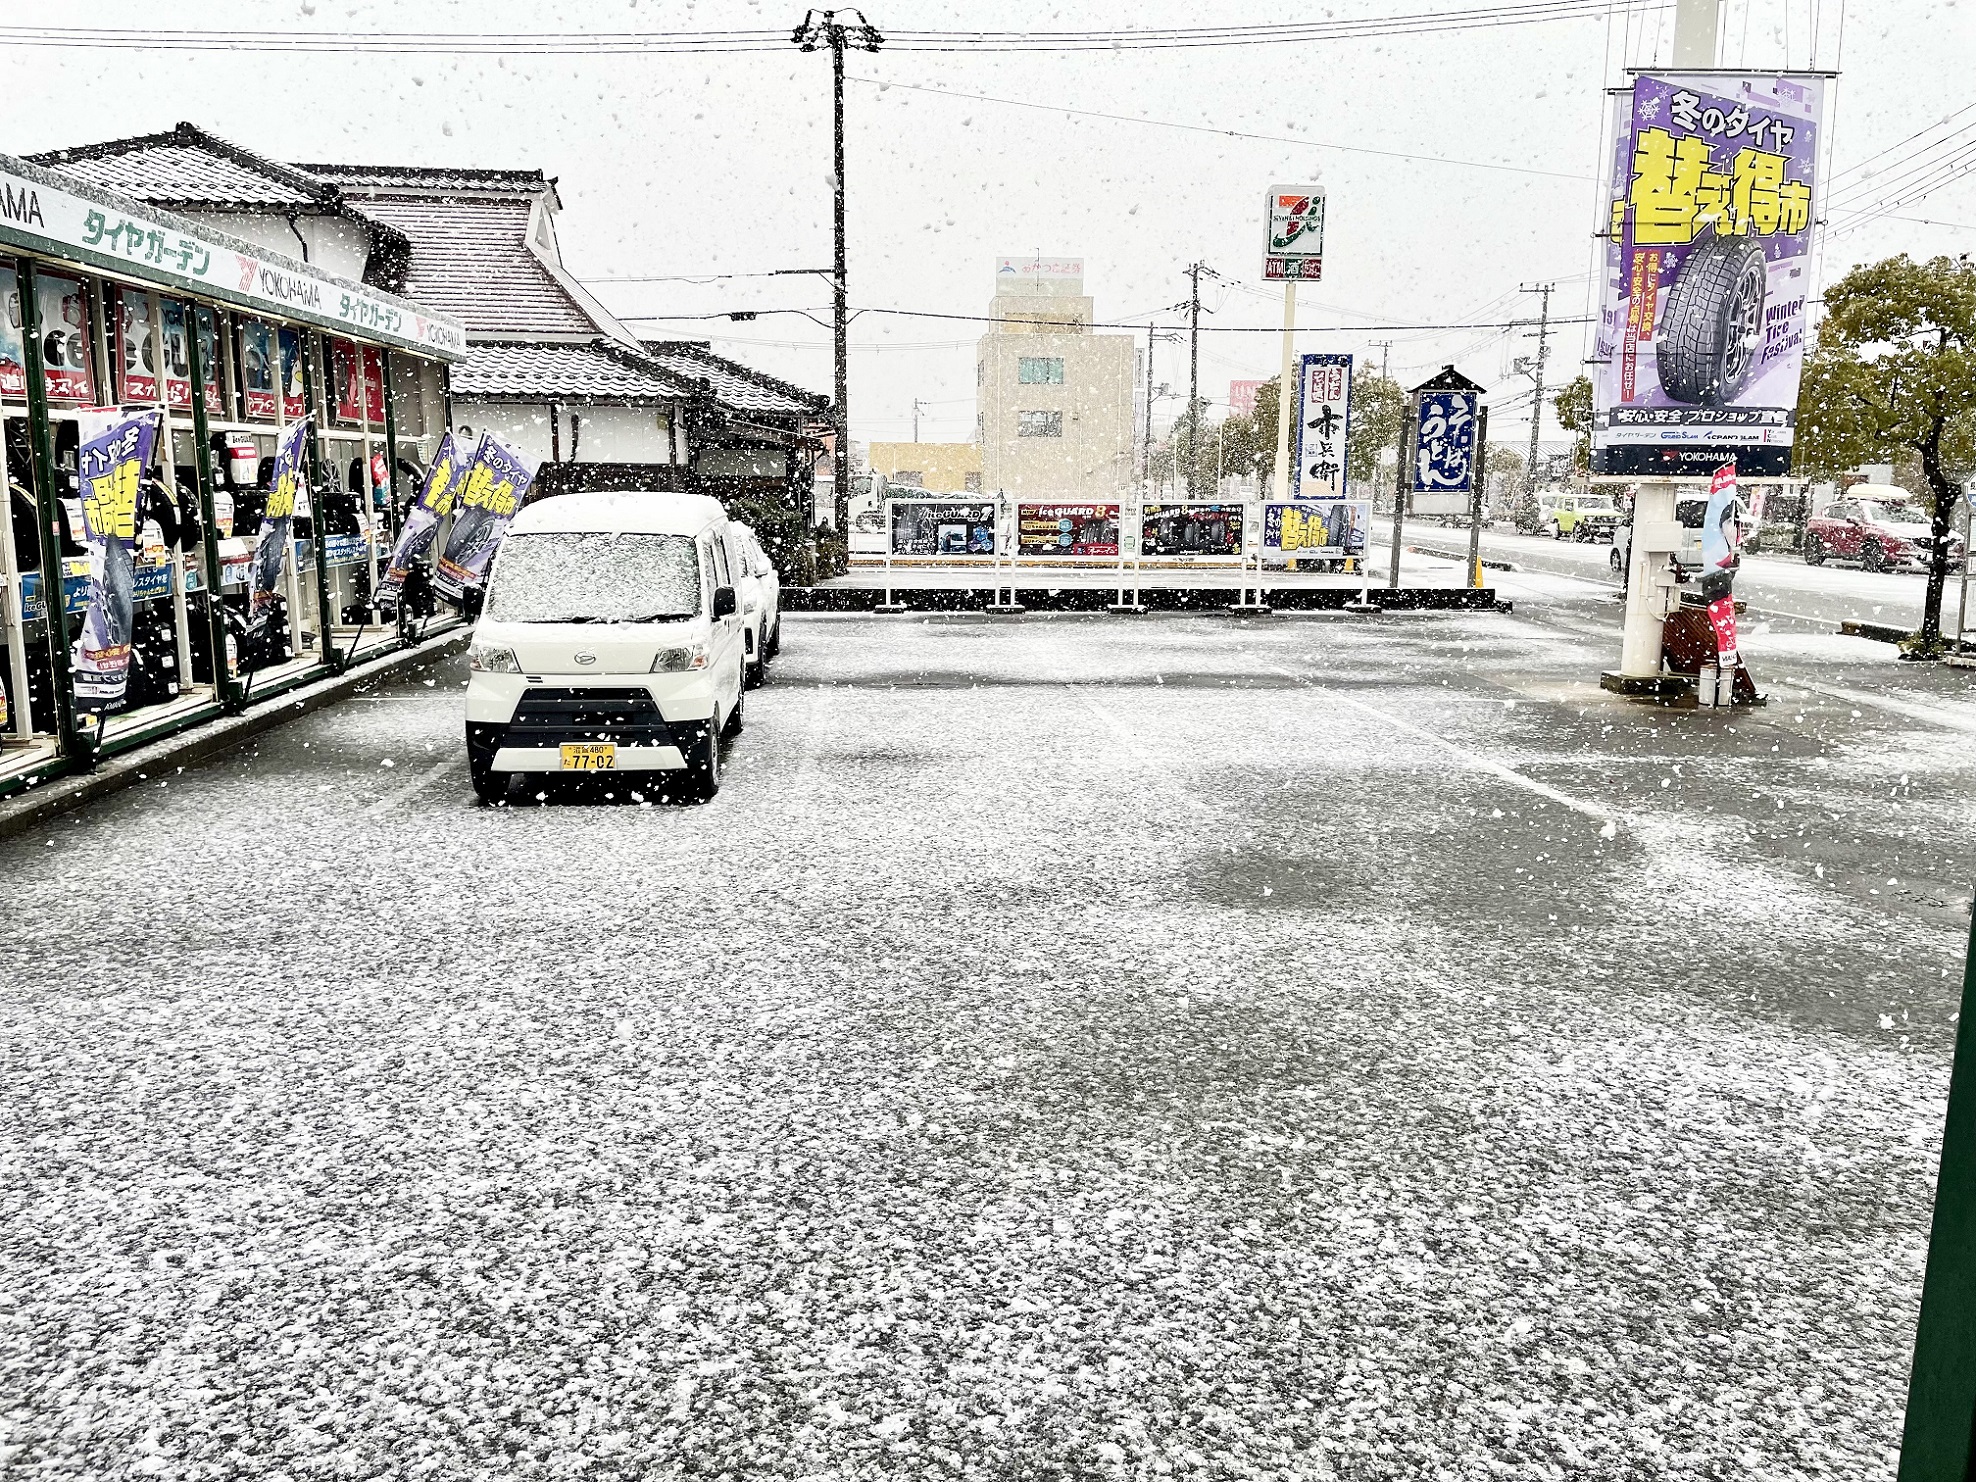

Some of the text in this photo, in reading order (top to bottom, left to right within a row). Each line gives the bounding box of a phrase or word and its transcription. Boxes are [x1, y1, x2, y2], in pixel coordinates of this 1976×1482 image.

[1671, 91, 1794, 153] 冬のタイヤ
[1631, 126, 1812, 245] 替え得市
[82, 208, 210, 275] タイヤガーデン
[1266, 261, 1284, 274] ATM
[258, 267, 322, 310] YOKOHAMA
[339, 293, 401, 332] タイヤガーデン
[1766, 295, 1805, 326] Winter
[427, 323, 461, 350] YOKOHAMA
[1766, 321, 1789, 344] Tire
[1419, 404, 1467, 486] うどん
[1680, 452, 1737, 461] YOKOHAMA
[483, 445, 528, 486] 冬のタイヤ
[573, 755, 614, 769] 77-02
[590, 746, 604, 754] 480
